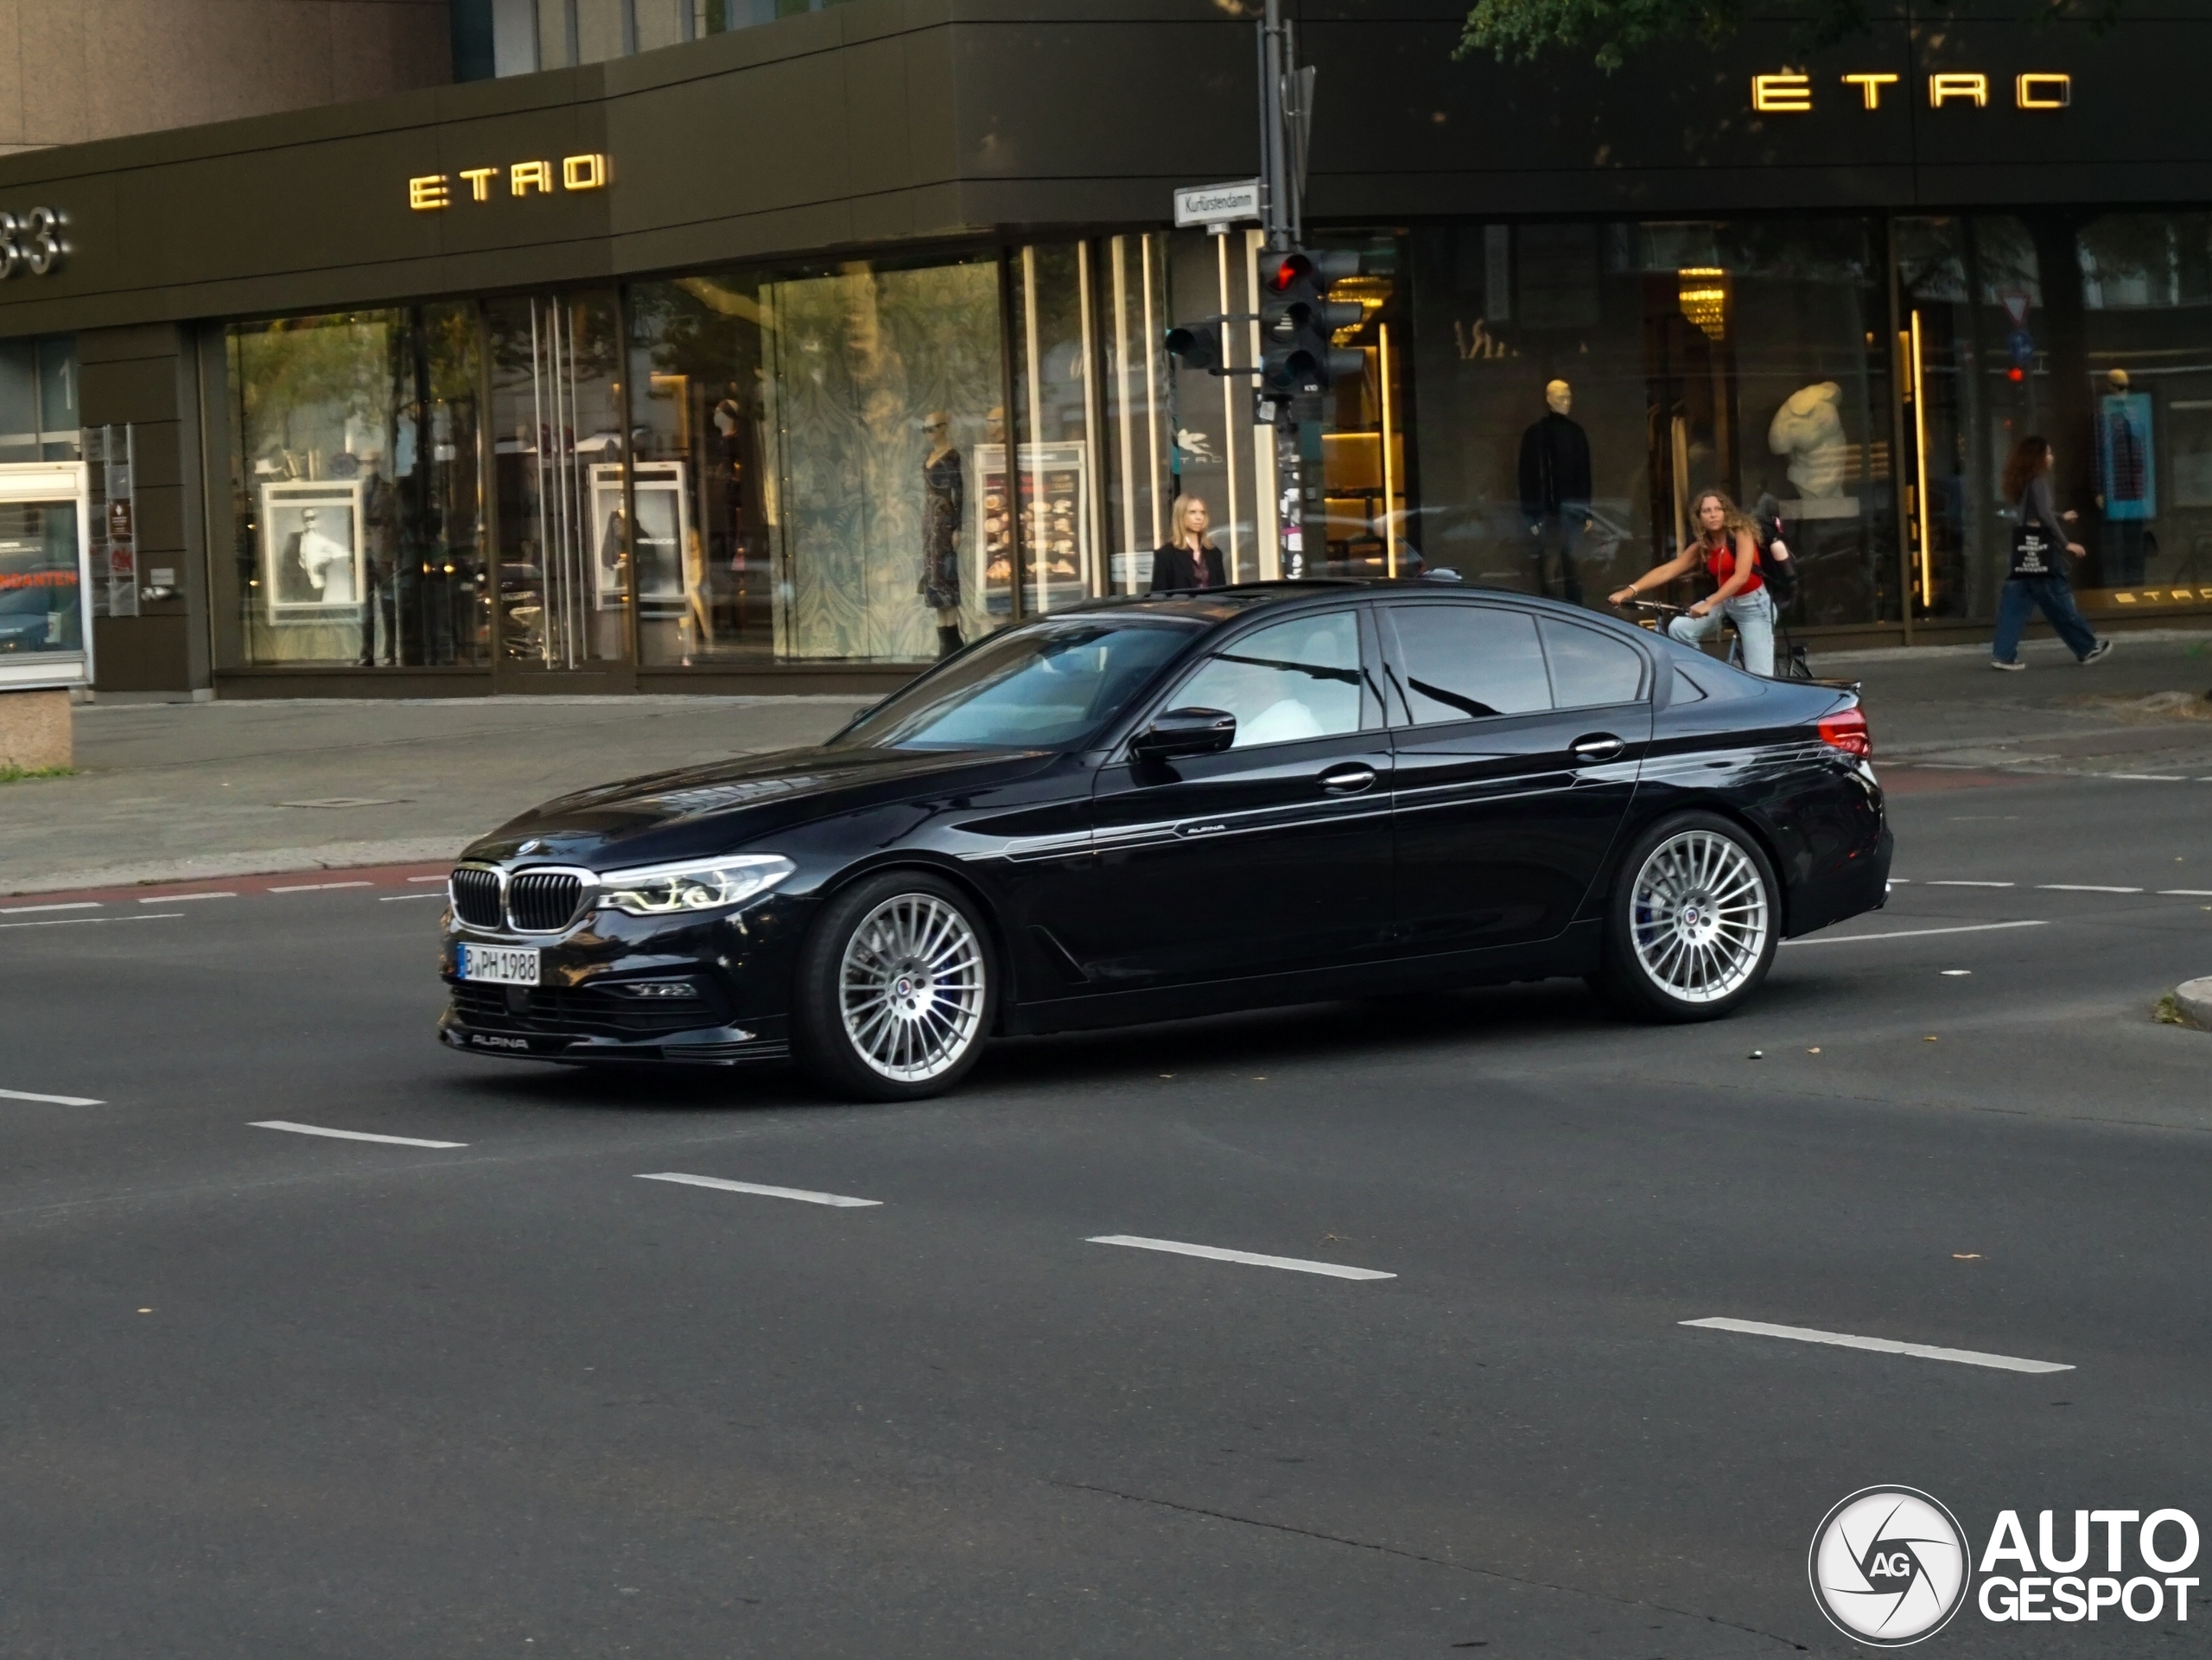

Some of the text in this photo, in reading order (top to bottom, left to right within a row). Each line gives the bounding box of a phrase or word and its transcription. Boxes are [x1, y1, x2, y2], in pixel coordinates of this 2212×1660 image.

[1751, 73, 2071, 110] ETRO
[409, 154, 606, 209] ETRO
[1185, 192, 1252, 213] Kurfürstendamm
